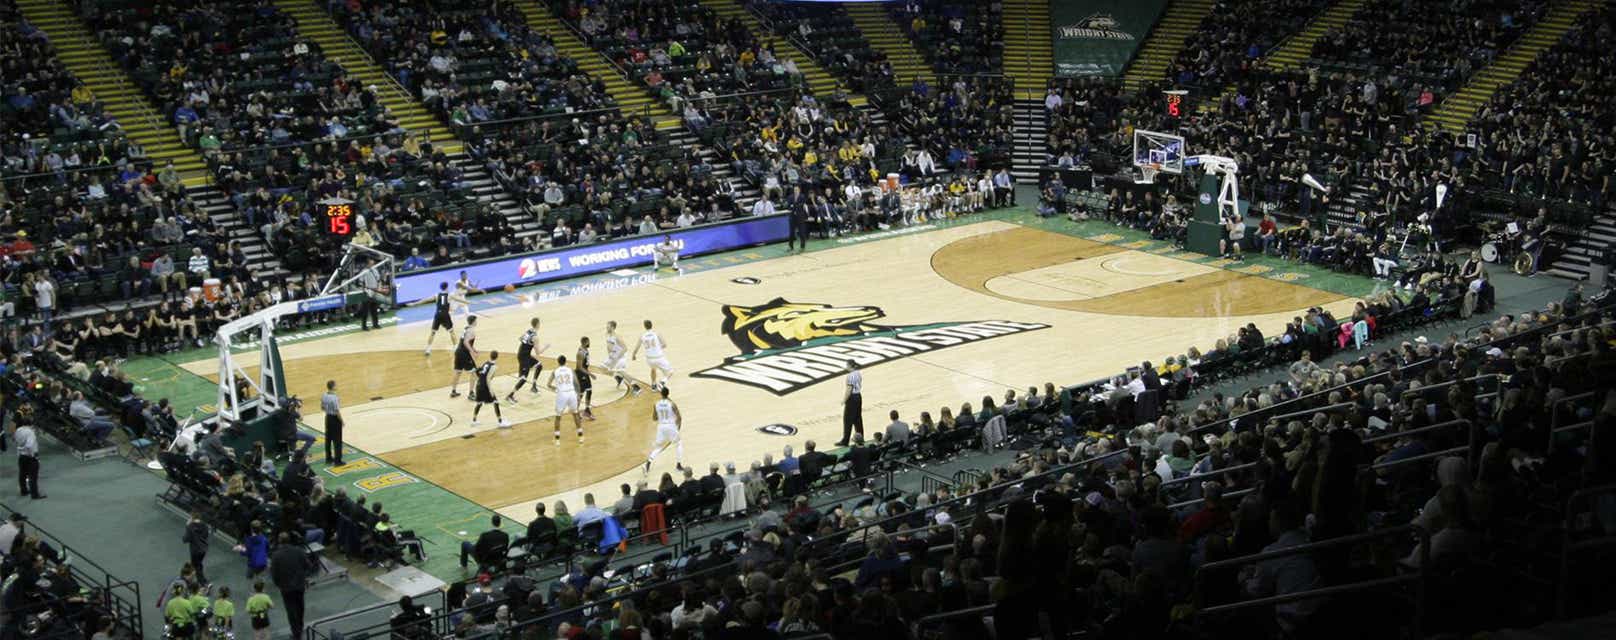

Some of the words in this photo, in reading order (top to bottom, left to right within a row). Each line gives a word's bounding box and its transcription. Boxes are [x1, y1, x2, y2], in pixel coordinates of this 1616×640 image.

[1062, 27, 1105, 38] WRIGHT
[327, 205, 351, 216] 2:35
[330, 215, 351, 234] 15
[568, 247, 629, 268] WORKING
[630, 242, 656, 257] FOR
[700, 336, 932, 391] WRIGHT
[897, 320, 1049, 346] STATE
